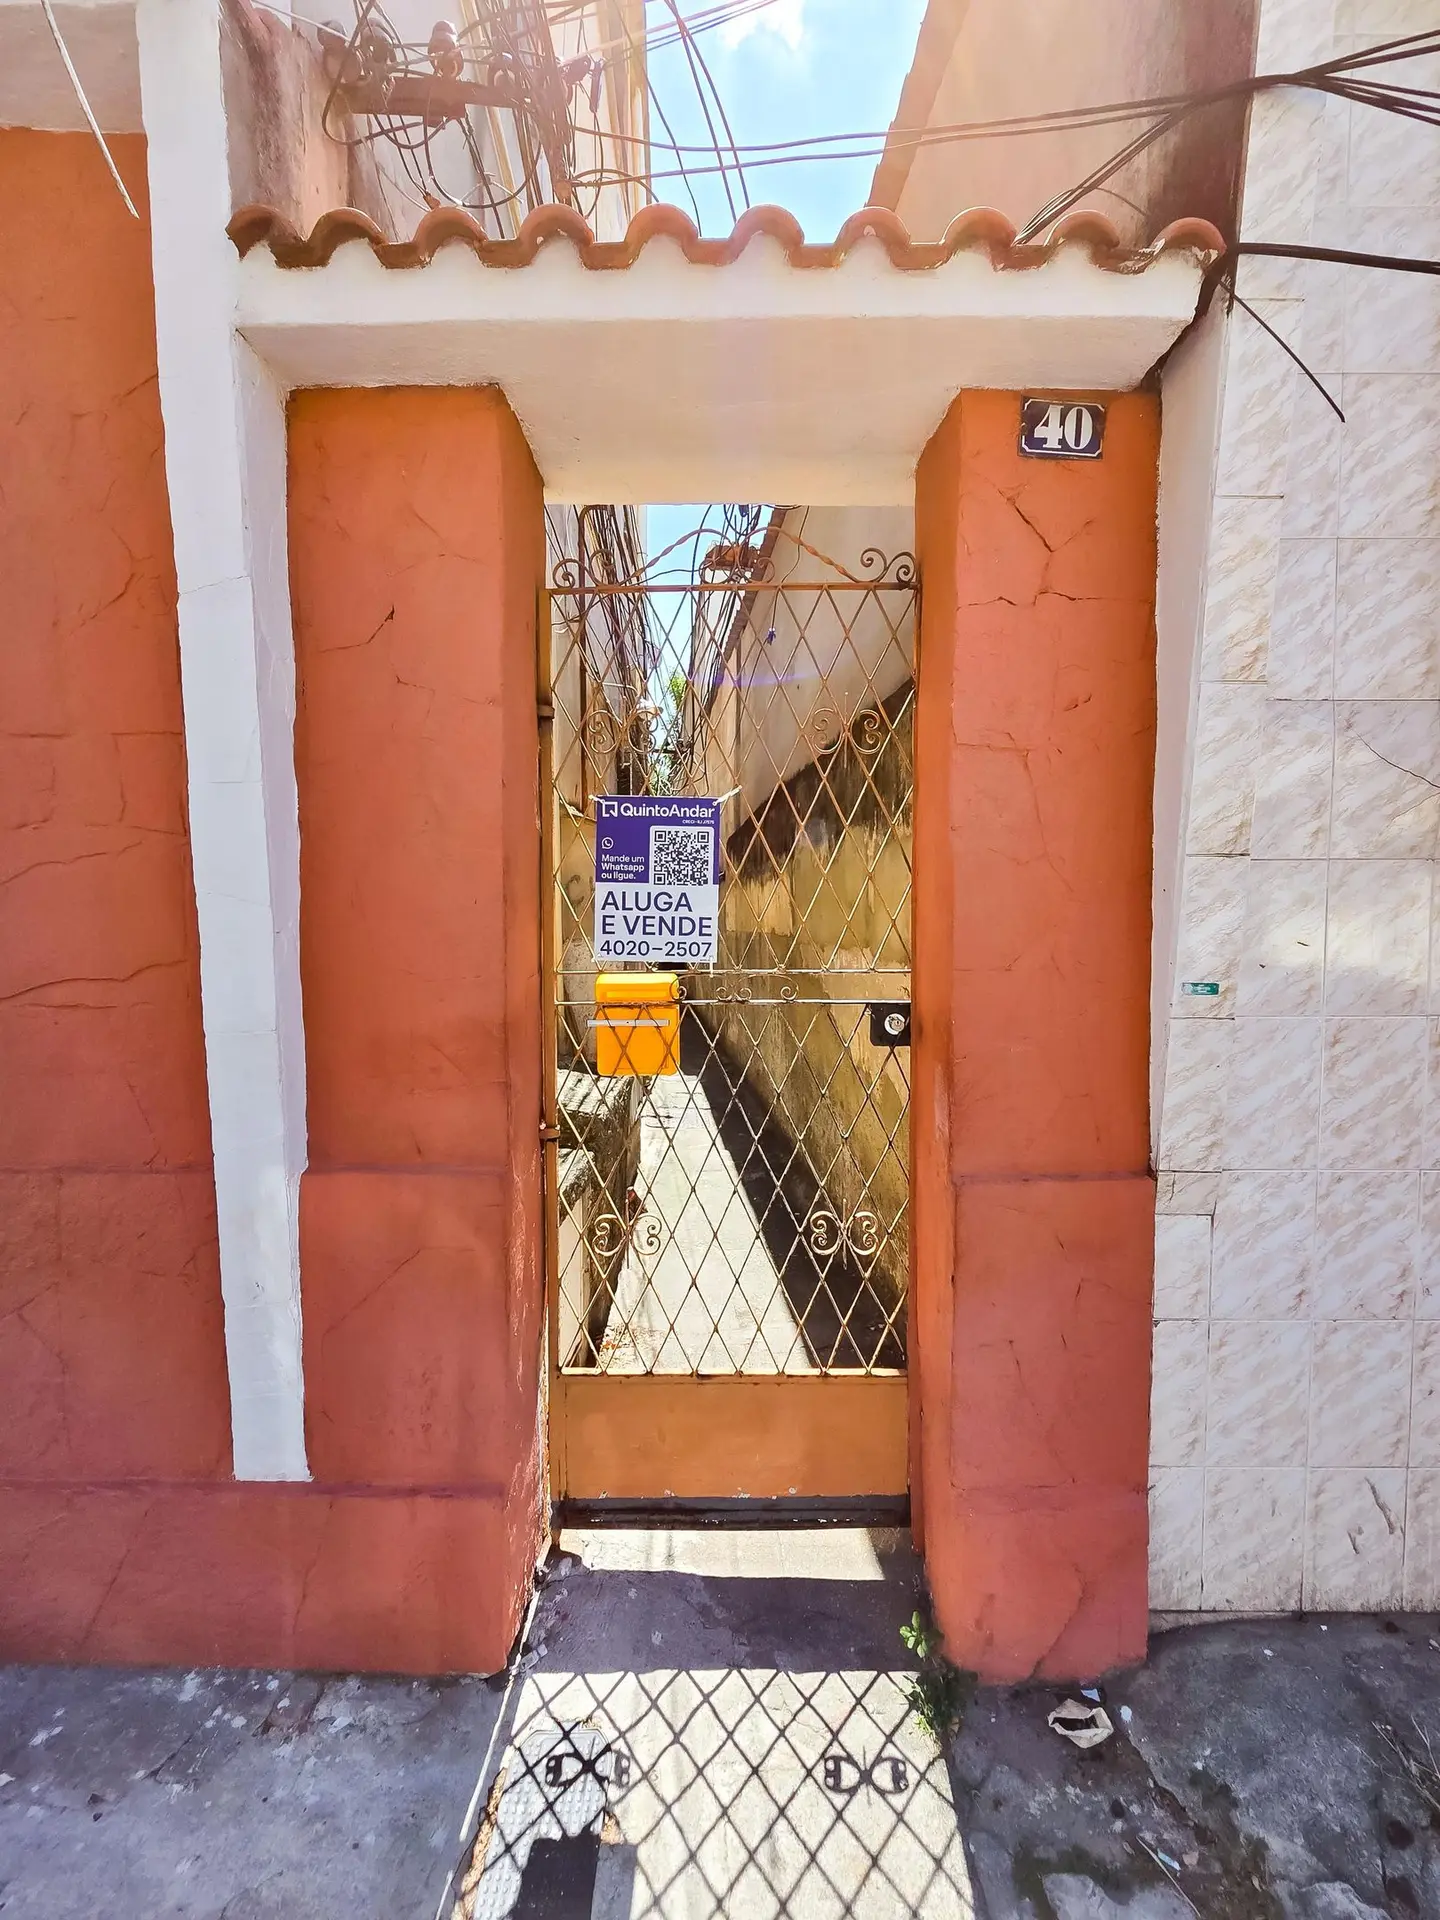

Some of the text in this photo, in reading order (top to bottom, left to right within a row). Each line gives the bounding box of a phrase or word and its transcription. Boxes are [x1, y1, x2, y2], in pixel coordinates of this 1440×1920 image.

[1034, 404, 1093, 450] 40
[620, 803, 715, 818] QuintoAndar
[601, 854, 645, 863] Mande um
[601, 863, 645, 872] Whatsapp
[613, 871, 636, 880] ligue.
[601, 890, 693, 913] ALUGA
[602, 915, 713, 937] E VENDE
[600, 940, 712, 957] 4020-2507
